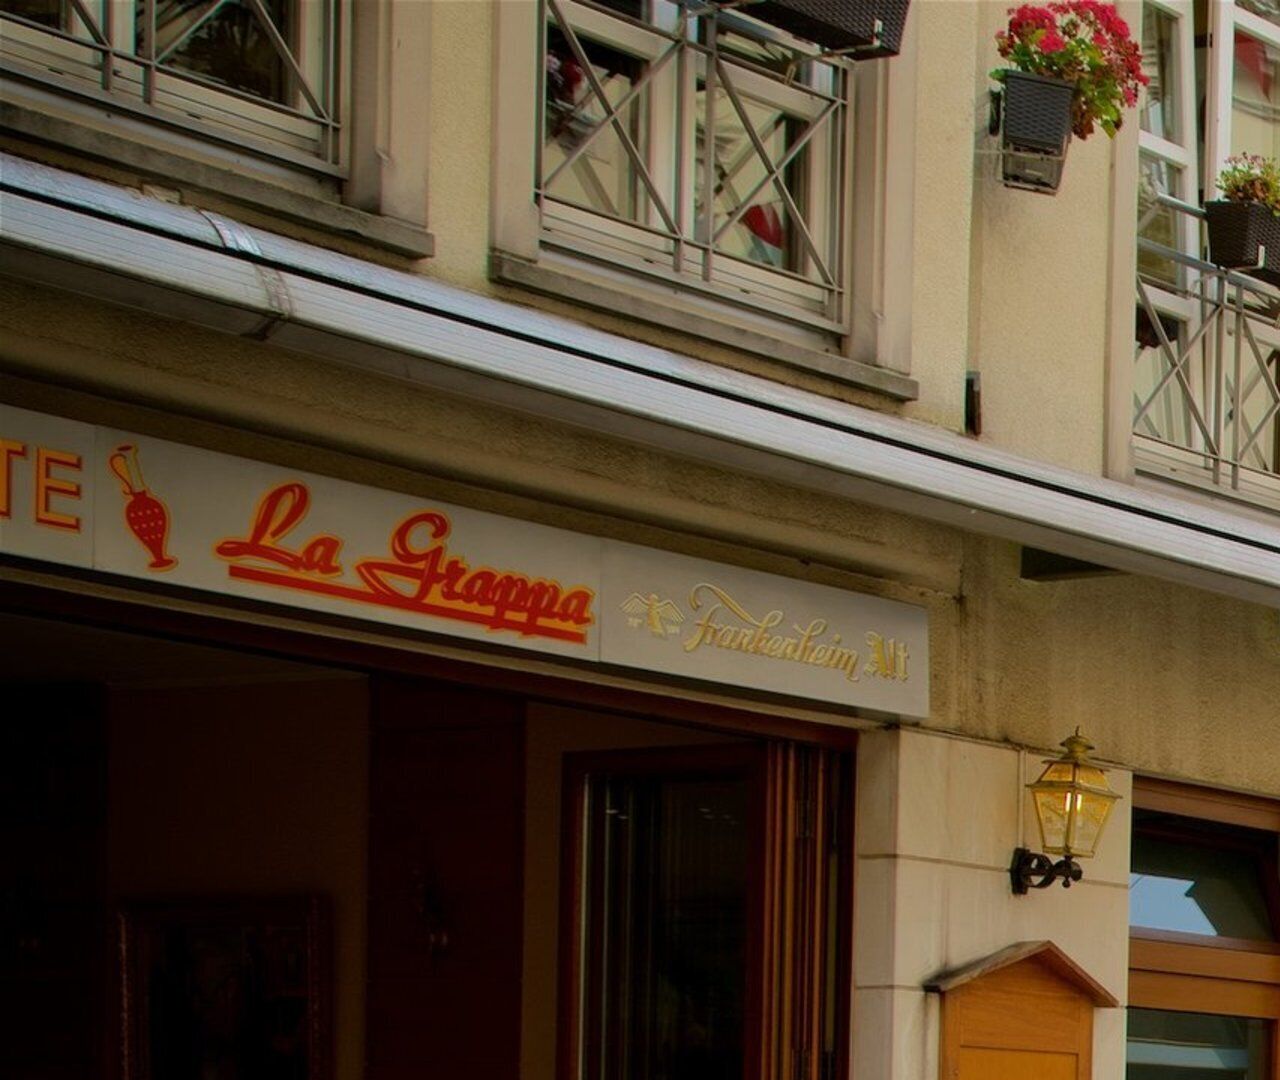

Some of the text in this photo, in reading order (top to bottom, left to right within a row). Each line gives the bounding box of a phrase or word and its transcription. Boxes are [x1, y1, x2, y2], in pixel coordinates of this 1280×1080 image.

[214, 480, 596, 638] La Grappa
[683, 583, 911, 682] Frankenheim Alt
